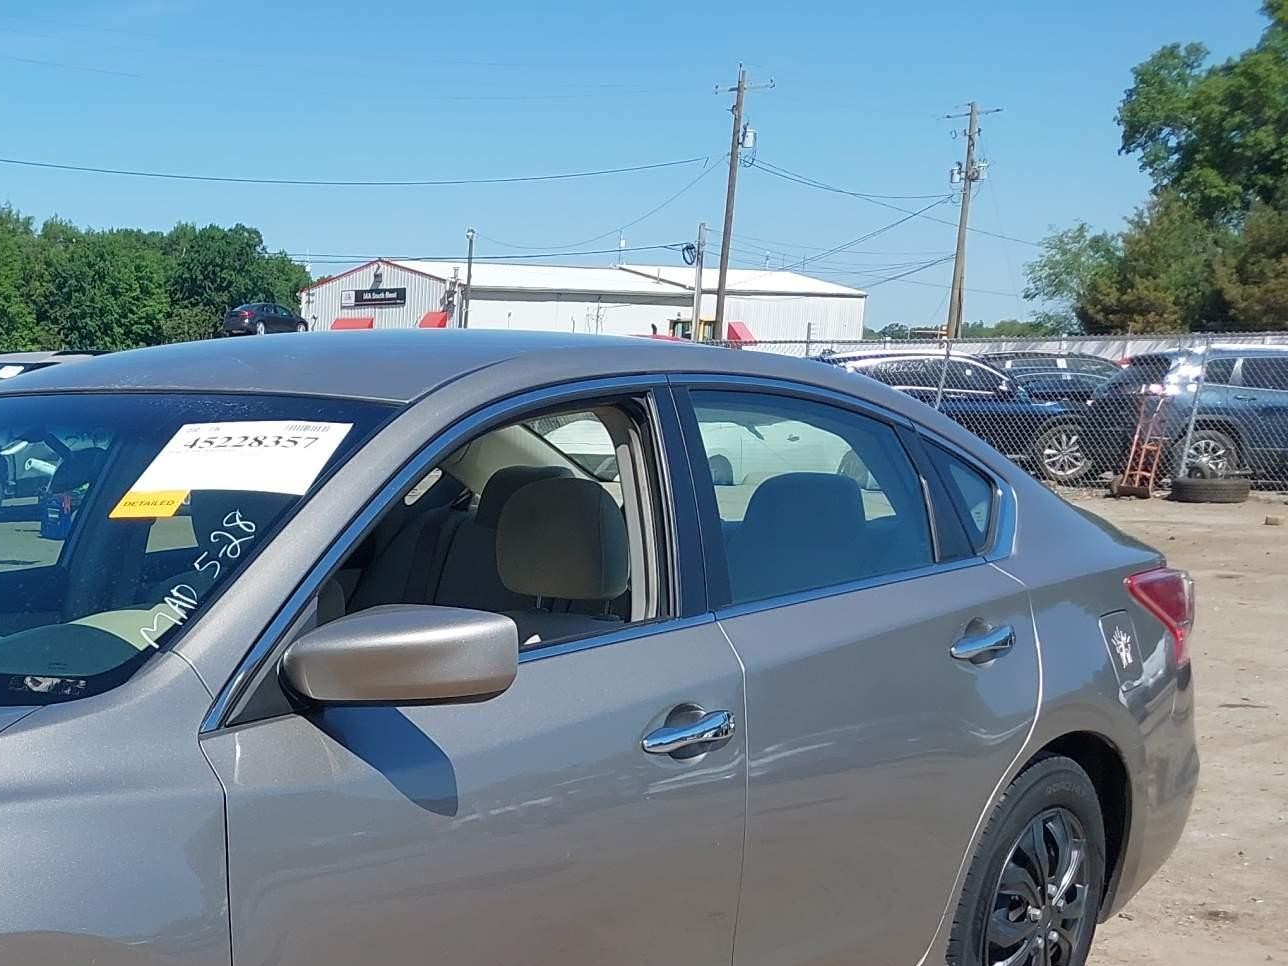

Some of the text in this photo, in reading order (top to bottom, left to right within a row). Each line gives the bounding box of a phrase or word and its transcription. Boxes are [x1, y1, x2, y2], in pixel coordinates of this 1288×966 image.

[183, 435, 320, 449] 45228357
[123, 499, 175, 507] DETAILED
[140, 584, 198, 649] MAD
[193, 508, 256, 578] 5-28
